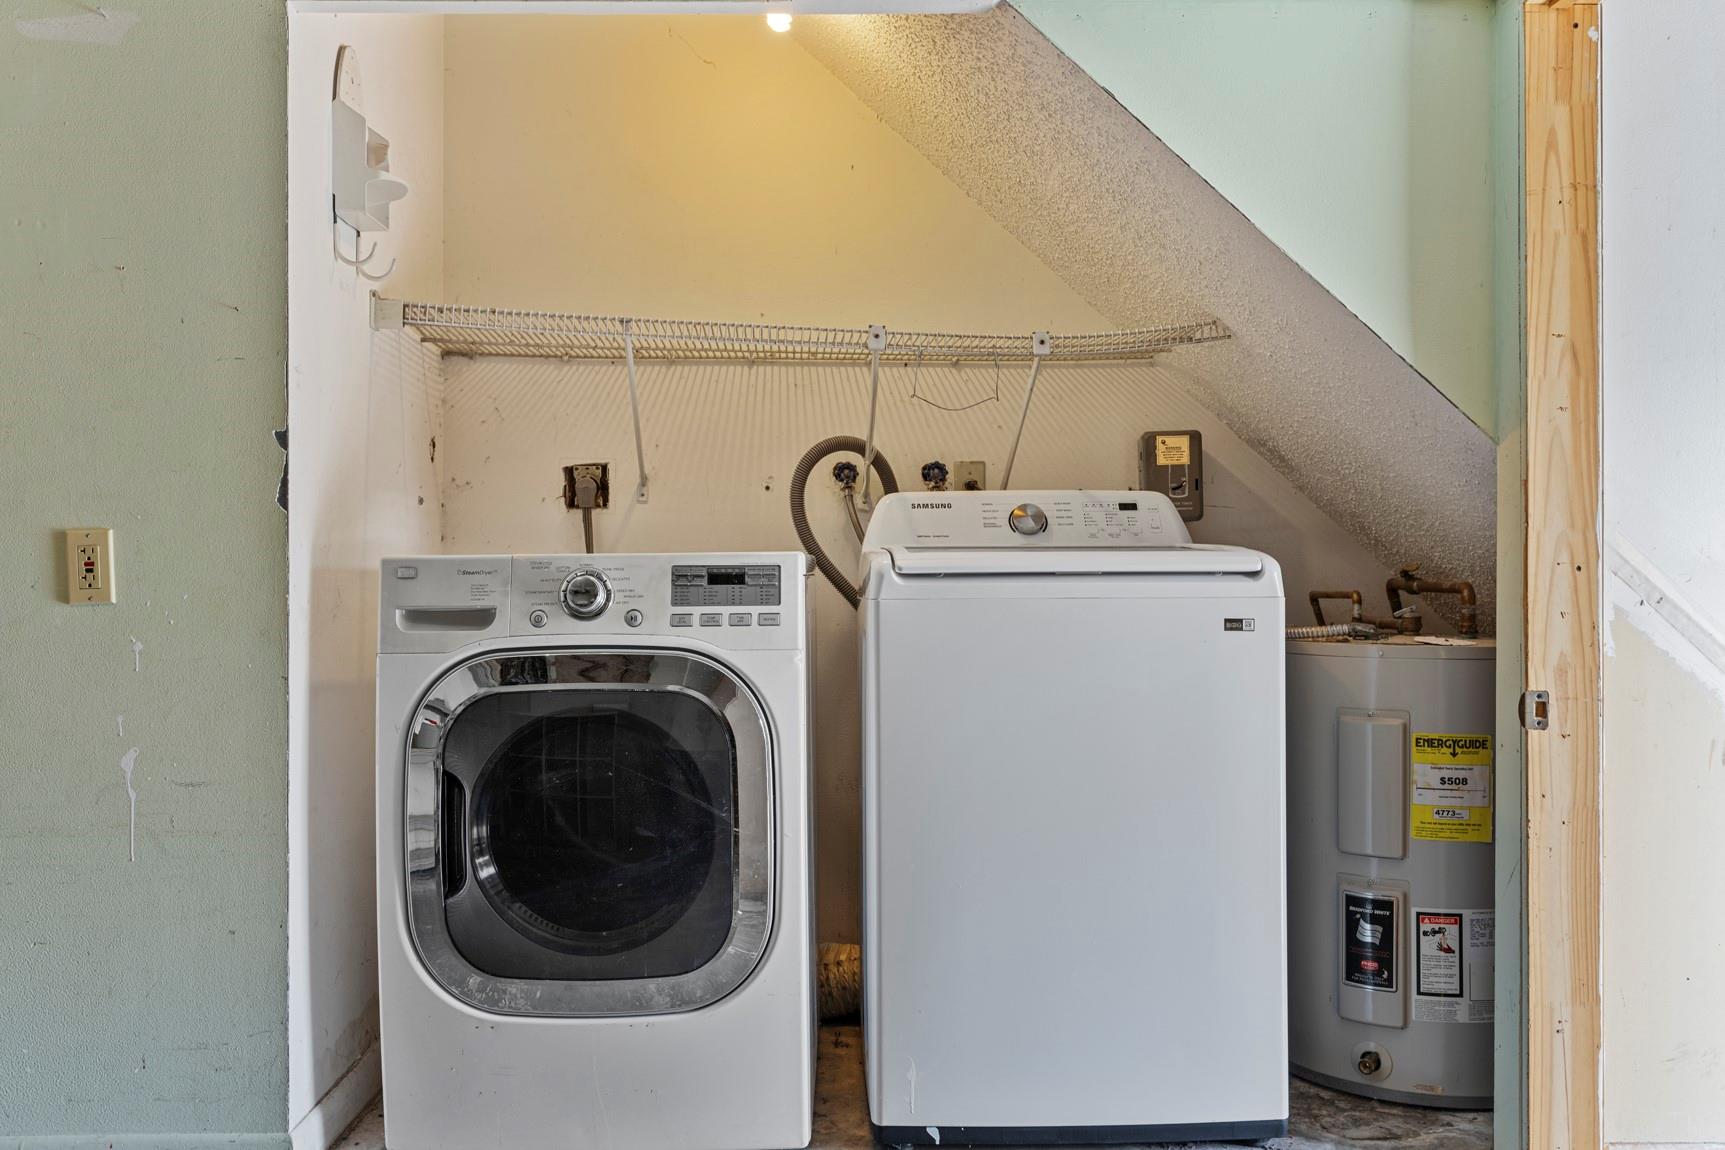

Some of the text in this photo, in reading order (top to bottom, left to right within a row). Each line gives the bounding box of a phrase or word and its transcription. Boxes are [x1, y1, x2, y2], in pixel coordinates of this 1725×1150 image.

[1415, 737, 1489, 751] ENERGYGUIDE
[1439, 776, 1468, 786] $508
[1434, 809, 1456, 817] 4773
